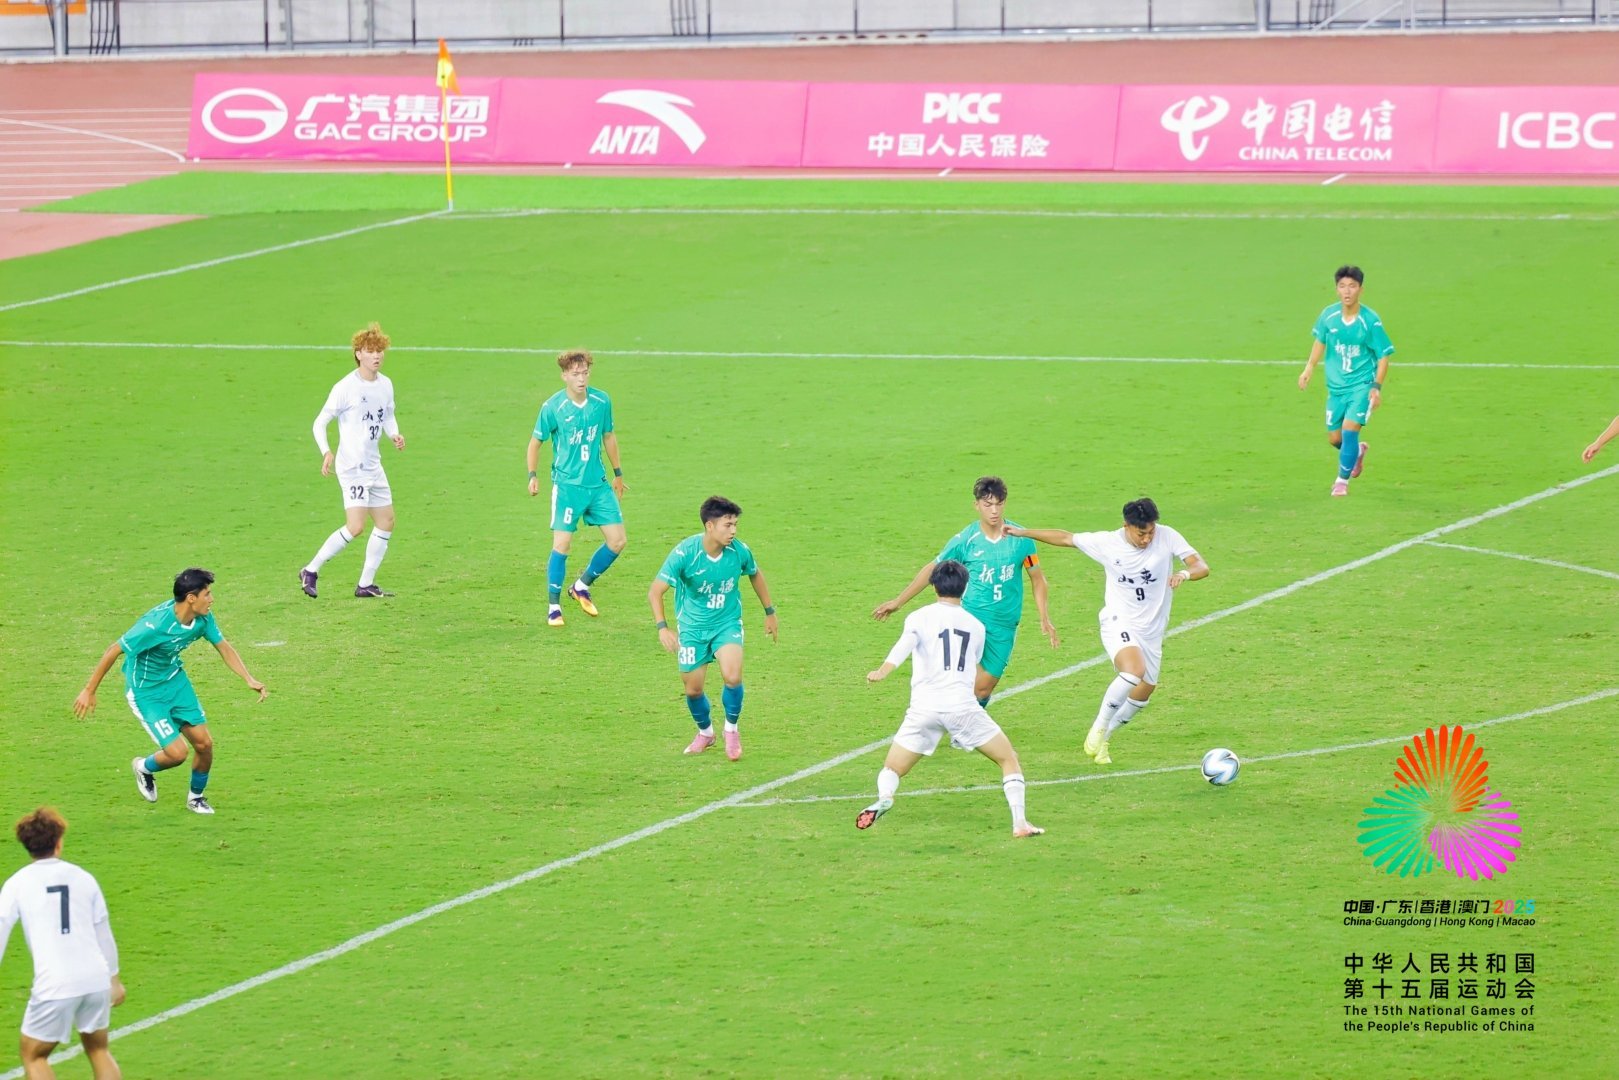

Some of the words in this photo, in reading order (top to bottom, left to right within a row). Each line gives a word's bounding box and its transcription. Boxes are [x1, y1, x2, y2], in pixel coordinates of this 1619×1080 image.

[295, 93, 490, 123] 广汽集团
[923, 92, 1002, 124] PICC
[1241, 97, 1395, 144] 中国电信
[294, 123, 363, 141] GAC
[367, 123, 488, 143] GROUP
[590, 125, 659, 154] ANTA
[1497, 112, 1616, 149] ICBC
[867, 132, 1050, 158] 中国人民保险
[1239, 146, 1299, 161] CHINA
[1305, 146, 1392, 161] TELECOM
[369, 425, 379, 441] 32
[581, 444, 589, 462] 6
[350, 485, 364, 500] 32
[563, 506, 573, 525] 6
[707, 593, 725, 609] 38
[993, 584, 1002, 601] 5
[1135, 587, 1146, 602] 9
[1120, 631, 1130, 643] 9
[679, 646, 696, 665] 38
[938, 628, 971, 672] 17
[153, 718, 174, 739] 15
[46, 885, 70, 935] 7
